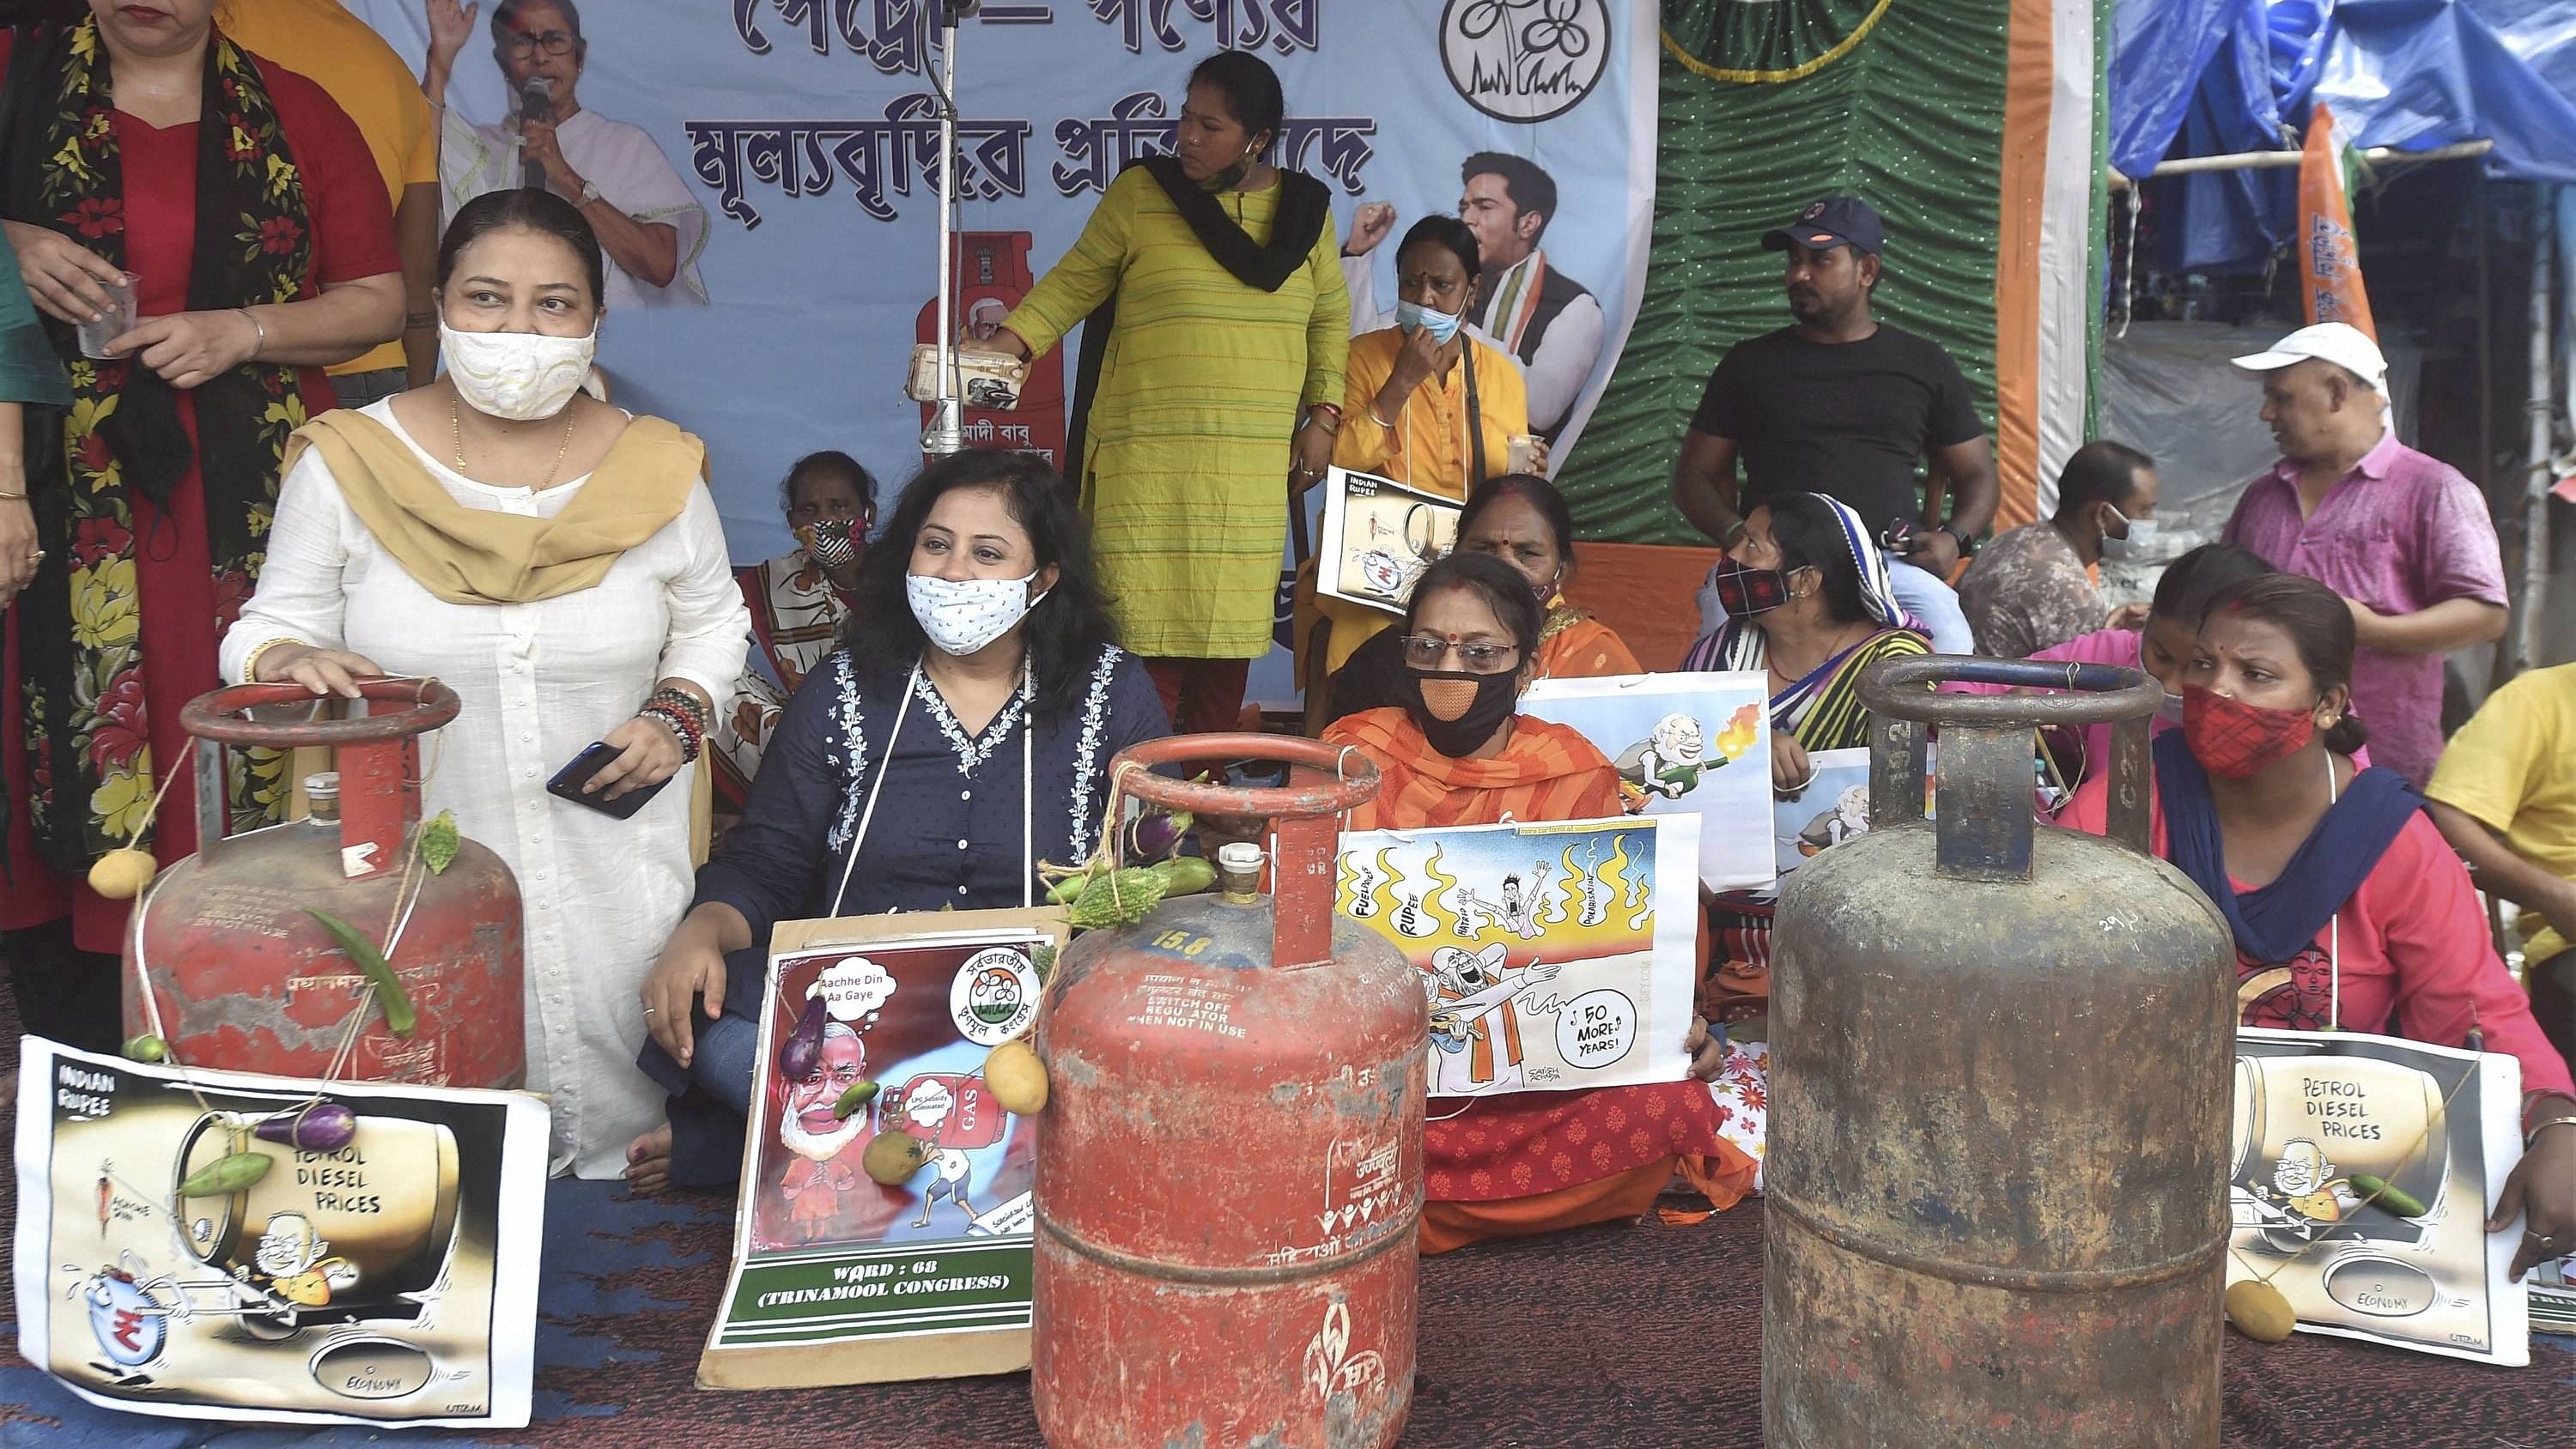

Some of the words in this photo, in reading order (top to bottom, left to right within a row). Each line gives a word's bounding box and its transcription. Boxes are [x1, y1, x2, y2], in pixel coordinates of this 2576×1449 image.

[998, 423, 1034, 447] বাবু
[1349, 484, 1376, 496] RUPEE
[1350, 476, 1378, 488] INDIAN
[1583, 872, 1595, 925] POLARISATION
[1400, 893, 1419, 936] RUPEE
[965, 951, 1027, 976] সর্বভারতীয়
[820, 977, 861, 988] Aachhe
[865, 974, 884, 985] Din
[828, 992, 841, 1002] Aa
[845, 991, 874, 1003] Gaye
[1146, 996, 1201, 1009] SWITCH
[1204, 1001, 1231, 1014] OFF
[957, 1004, 990, 1037] তৃণমূল
[999, 1002, 1032, 1034] কংগ্রেস
[1585, 1005, 1607, 1024] 50
[1167, 1017, 1196, 1028] NOT
[1200, 1021, 1214, 1031] IN
[1218, 1023, 1248, 1039] USE
[1577, 1022, 1614, 1042] MORE
[1579, 1038, 1619, 1058] YEARS!
[58, 1064, 115, 1093] INDIAN
[2303, 1077, 2366, 1098] PETROL
[58, 1088, 111, 1116] RUPEE
[963, 1088, 978, 1131] GAS
[2306, 1101, 2370, 1118] DIESEL
[2322, 1121, 2381, 1141] PRICES
[297, 1167, 369, 1189] DIESEL
[314, 1191, 380, 1214] PRICES
[913, 1260, 938, 1275] 68
[757, 1282, 889, 1309] (TRINAMOOL
[893, 1275, 1011, 1295] CONGRESS)
[2356, 1292, 2409, 1310] ECONOMY
[2449, 1332, 2483, 1347] UTTAM
[346, 1375, 403, 1392] ECONOMY
